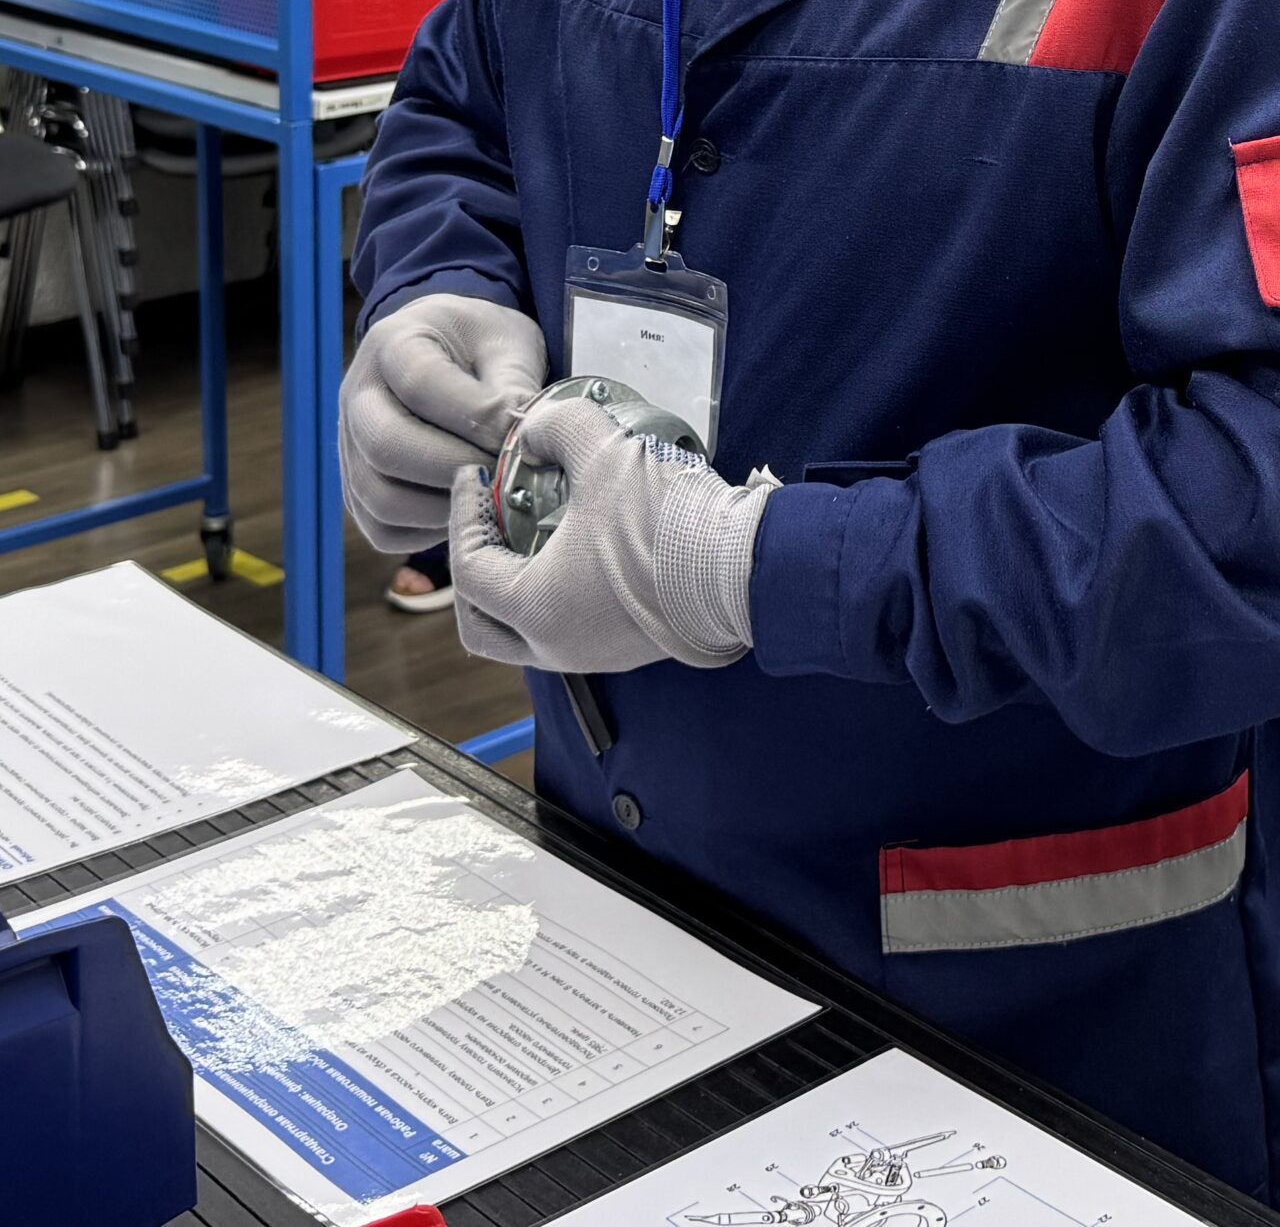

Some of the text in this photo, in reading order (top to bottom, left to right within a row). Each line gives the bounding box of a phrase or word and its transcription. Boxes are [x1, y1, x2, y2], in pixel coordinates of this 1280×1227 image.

[640, 329, 665, 343] Имя:
[215, 1067, 335, 1165] Стандартная операционная
[298, 1091, 348, 1131] Операция:
[325, 1067, 417, 1138] Рабочая пошаговая
[419, 1152, 438, 1164] №
[431, 1139, 461, 1159] шага
